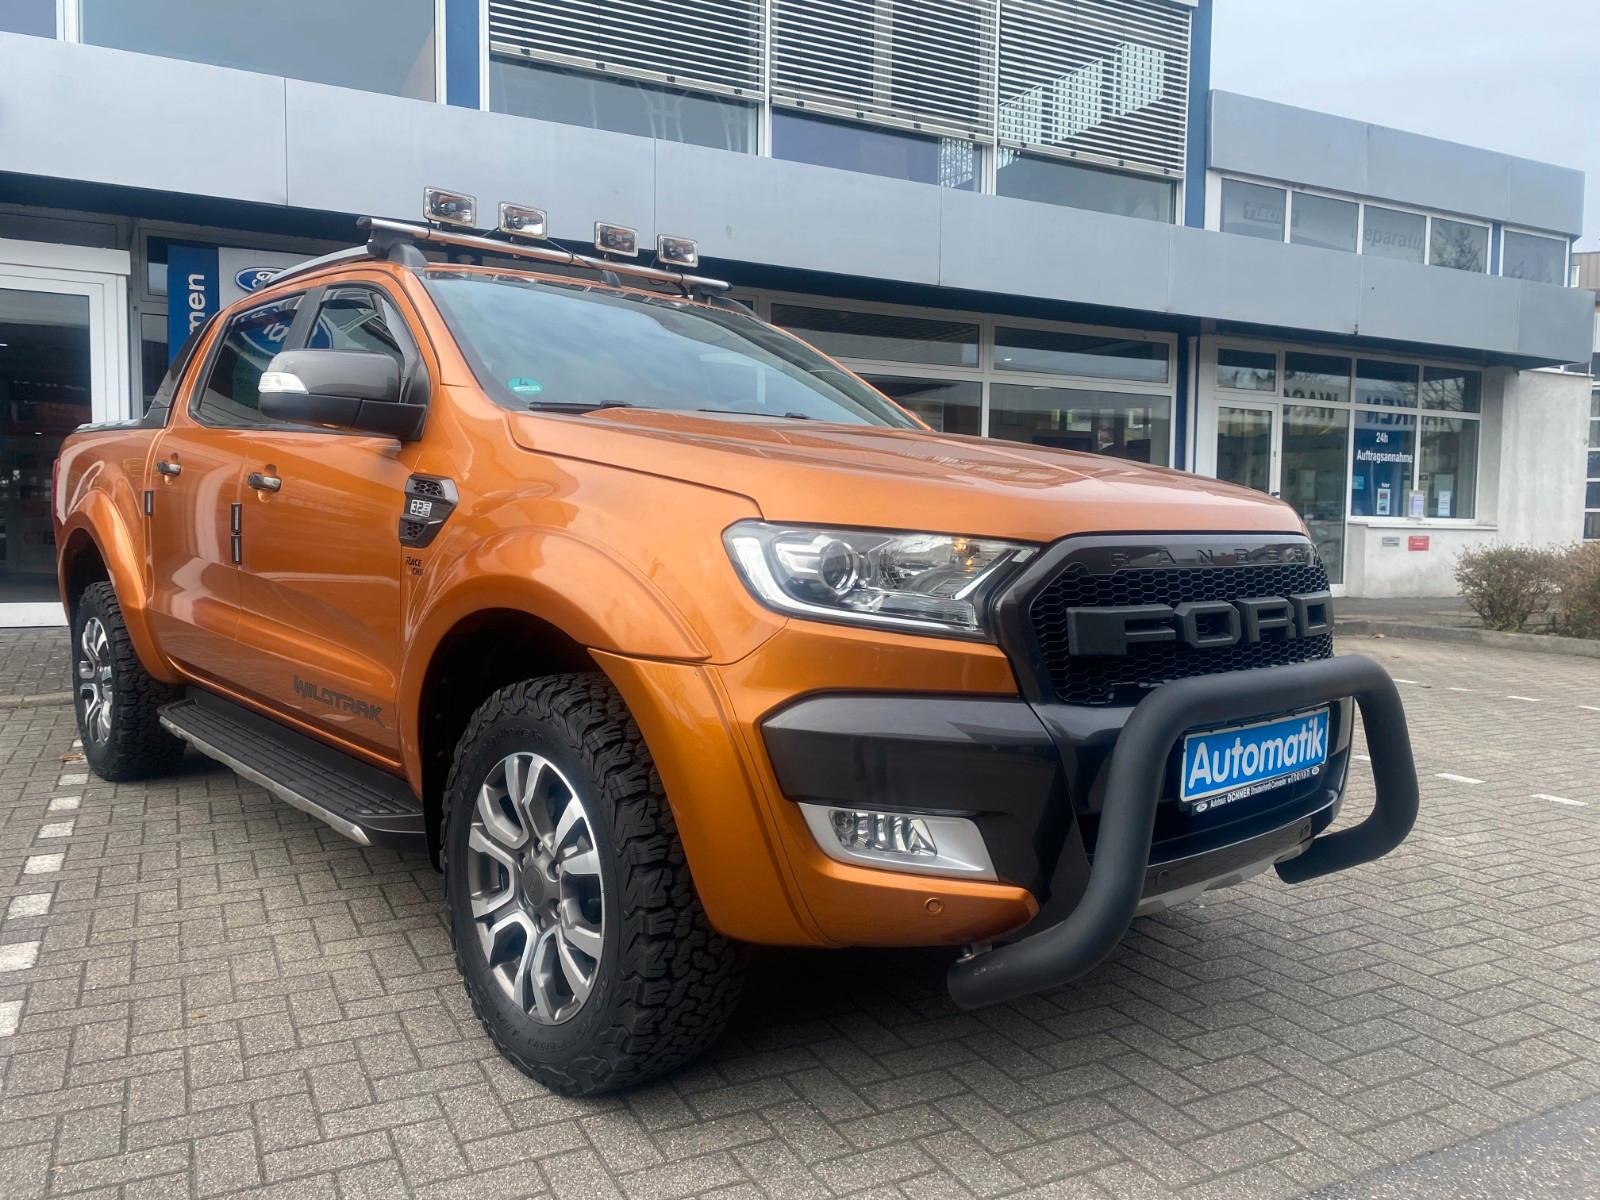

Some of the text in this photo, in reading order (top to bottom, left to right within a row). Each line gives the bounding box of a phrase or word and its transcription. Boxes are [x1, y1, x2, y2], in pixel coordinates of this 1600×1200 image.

[1357, 450, 1413, 464] Auftragsannahme
[1376, 432, 1389, 443] 24h
[1066, 591, 1335, 656] FORD
[293, 674, 385, 728] WILDTRAK
[1188, 717, 1324, 789] Automatik
